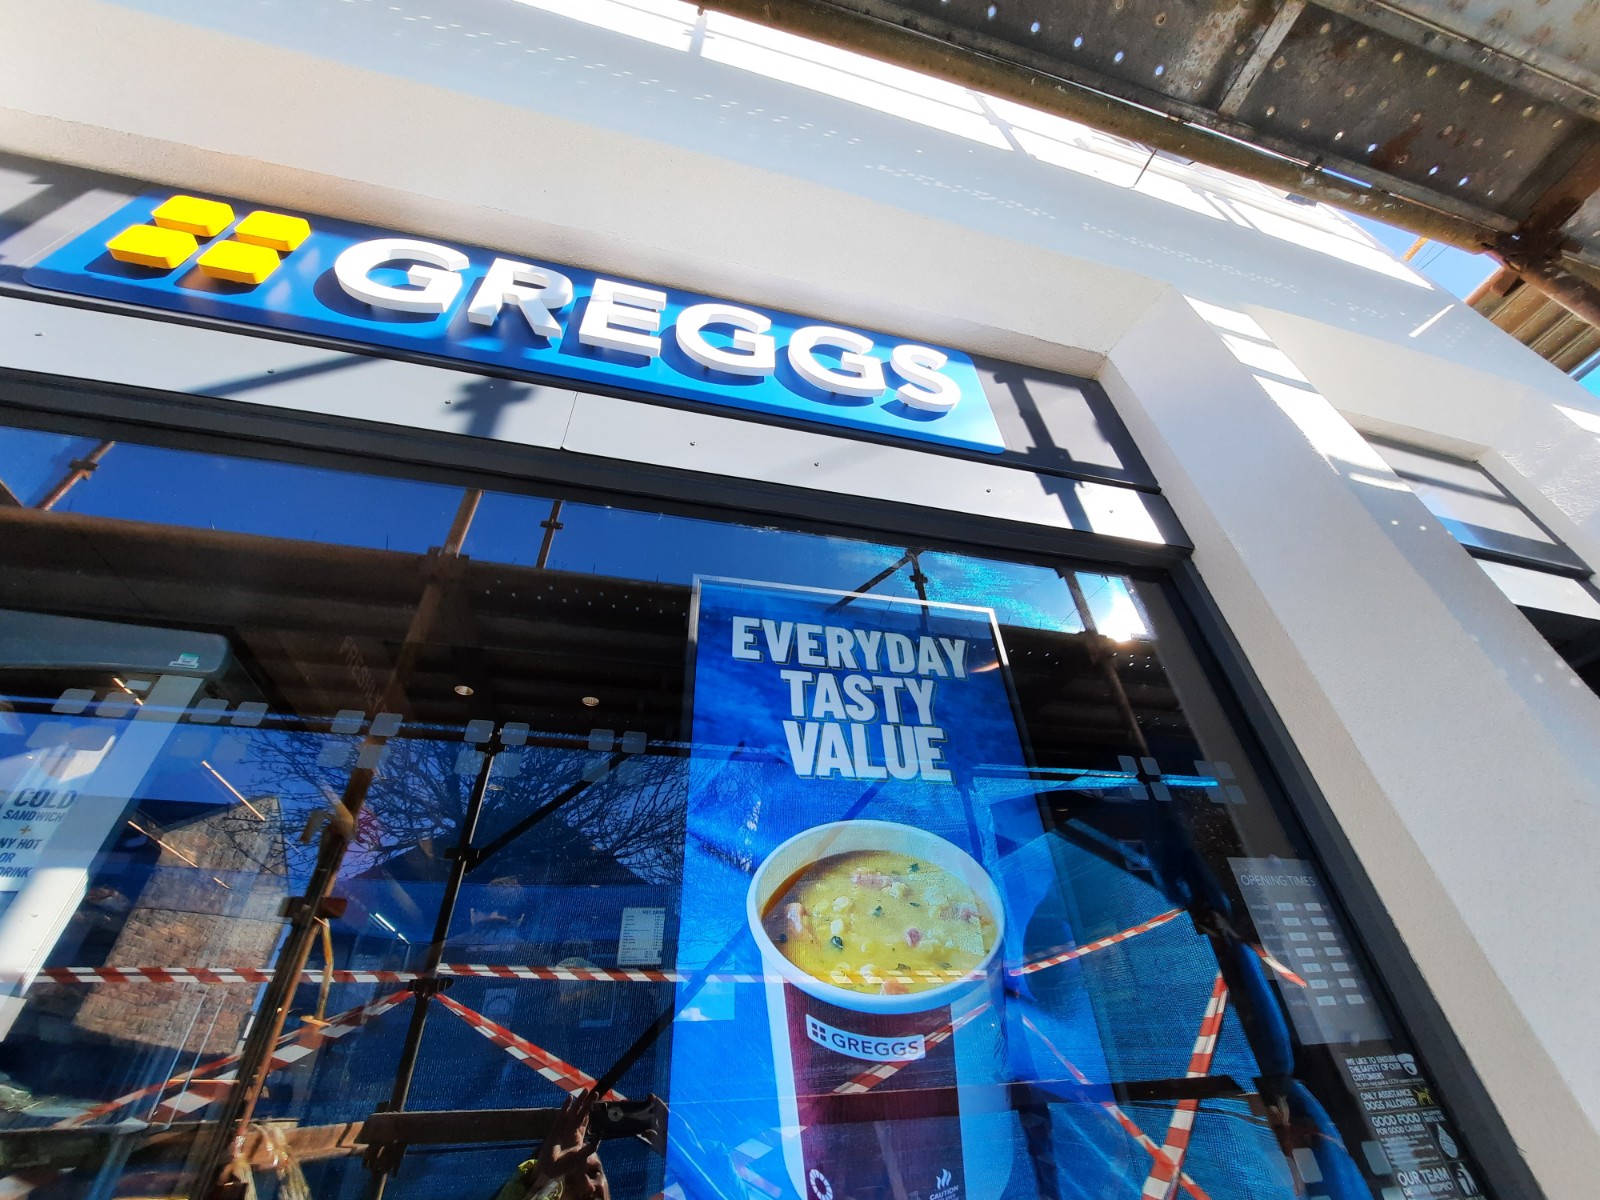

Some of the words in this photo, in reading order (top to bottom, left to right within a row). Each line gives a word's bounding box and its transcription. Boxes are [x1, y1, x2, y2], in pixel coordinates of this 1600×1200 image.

[333, 238, 961, 412] GREGGS
[732, 616, 968, 679] EVERYDAY
[780, 670, 936, 725] TASTY
[783, 720, 953, 783] VALUE
[13, 787, 78, 809] COLD
[3, 809, 66, 822] SANDWICH
[16, 839, 43, 850] HOT
[1240, 874, 1286, 886] OPENING
[1286, 875, 1316, 887] TIMES
[831, 1033, 919, 1056] GREGGS
[1355, 1057, 1369, 1065] LIKE
[1367, 1056, 1377, 1065] TO
[1348, 1065, 1361, 1074] THE
[1360, 1064, 1381, 1073] SAFETY
[1352, 1072, 1385, 1082] CUSTOMERS
[1360, 1090, 1377, 1101] ONLY
[1378, 1088, 1413, 1099] ASSISTANCE
[1364, 1101, 1385, 1111] DOGS
[1385, 1097, 1417, 1109] ALLOWED
[1372, 1115, 1397, 1127] GOOD
[1397, 1112, 1421, 1123] FOOD
[1376, 1127, 1389, 1136] FOR
[1388, 1126, 1405, 1135] GOOD
[1404, 1123, 1425, 1132] CAUSES
[1397, 1170, 1421, 1186] OUR
[1419, 1167, 1451, 1183] TEAM
[930, 1185, 959, 1200] CAUTION
